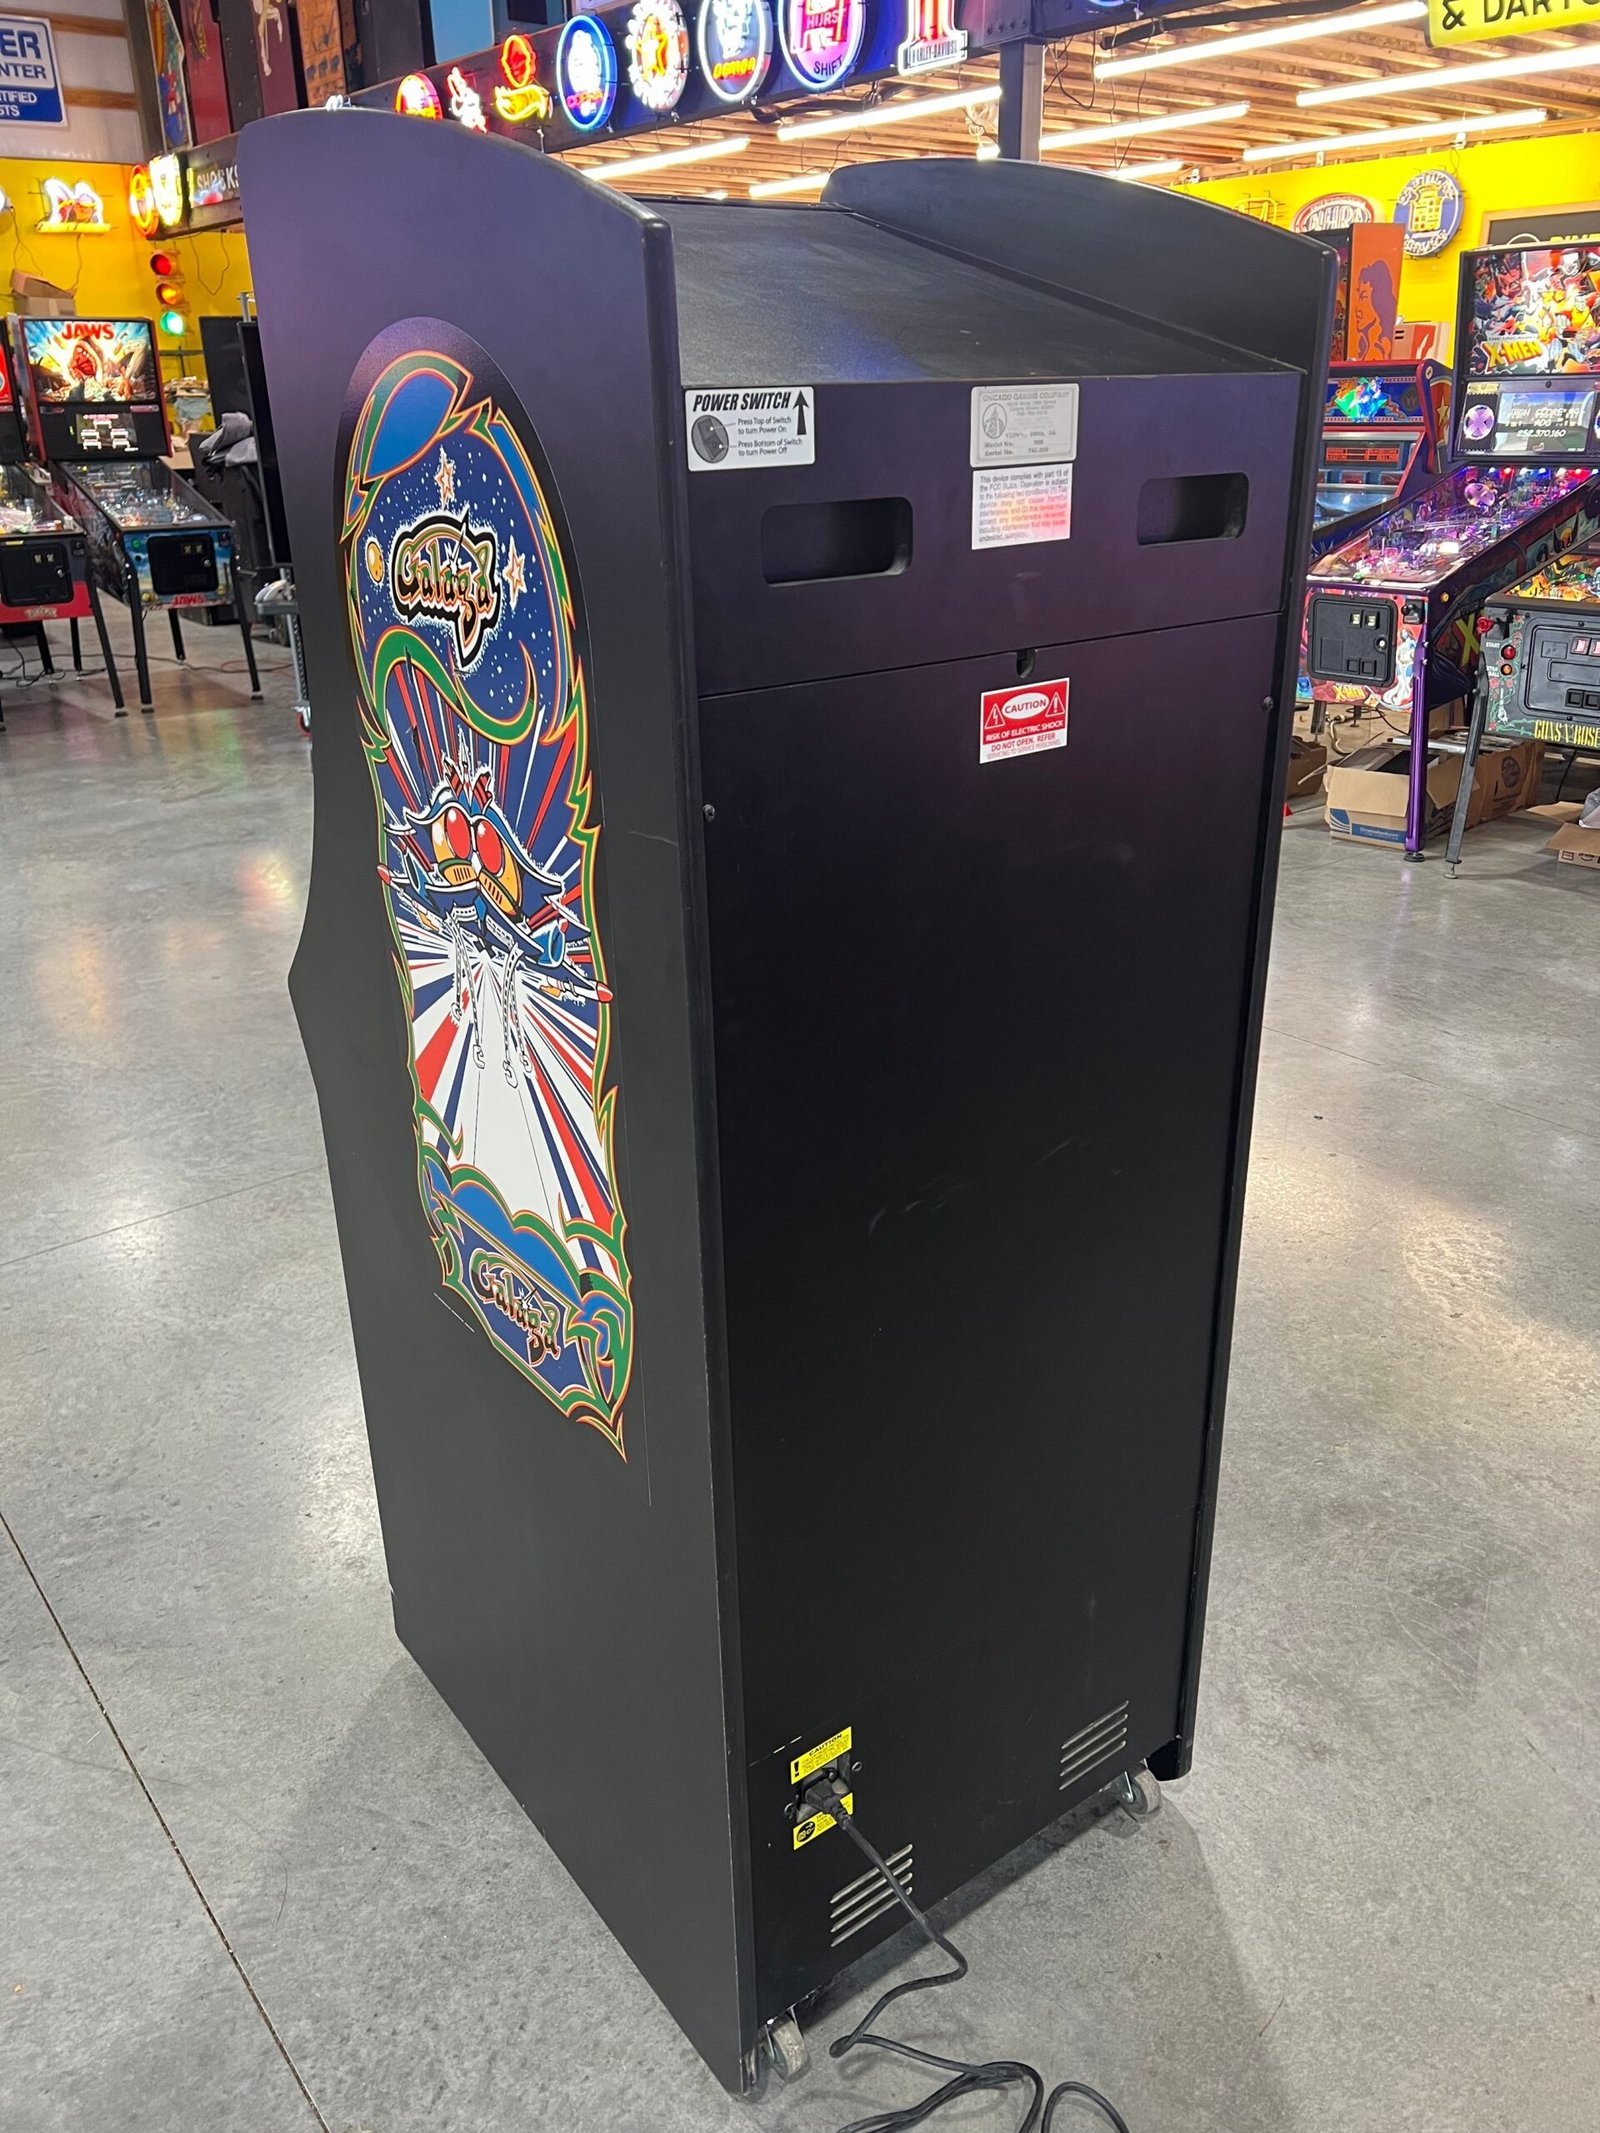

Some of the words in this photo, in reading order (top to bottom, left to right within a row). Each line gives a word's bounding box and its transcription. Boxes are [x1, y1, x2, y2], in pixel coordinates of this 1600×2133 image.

[61, 323, 115, 340] JAWS
[1482, 341, 1543, 368] X-MEN
[693, 393, 739, 412] POWER
[741, 391, 792, 410] SWITCH
[754, 417, 764, 426] Top
[766, 416, 772, 424] of
[772, 416, 792, 424] Switch
[738, 440, 753, 448] Press
[776, 438, 783, 446] of
[784, 438, 802, 446] Switch
[396, 521, 496, 652] Galaga
[1004, 699, 1046, 714] CAUTION
[986, 732, 1000, 742] RISK
[1001, 730, 1010, 738] OF
[1011, 724, 1040, 736] ELECTRIC
[1041, 720, 1064, 730] SHOCK
[991, 744, 1001, 752] DO
[1002, 740, 1016, 750] NOT
[1036, 732, 1056, 742] REFER
[469, 1248, 561, 1368] Galaga
[808, 1734, 843, 1756] CAUTION
